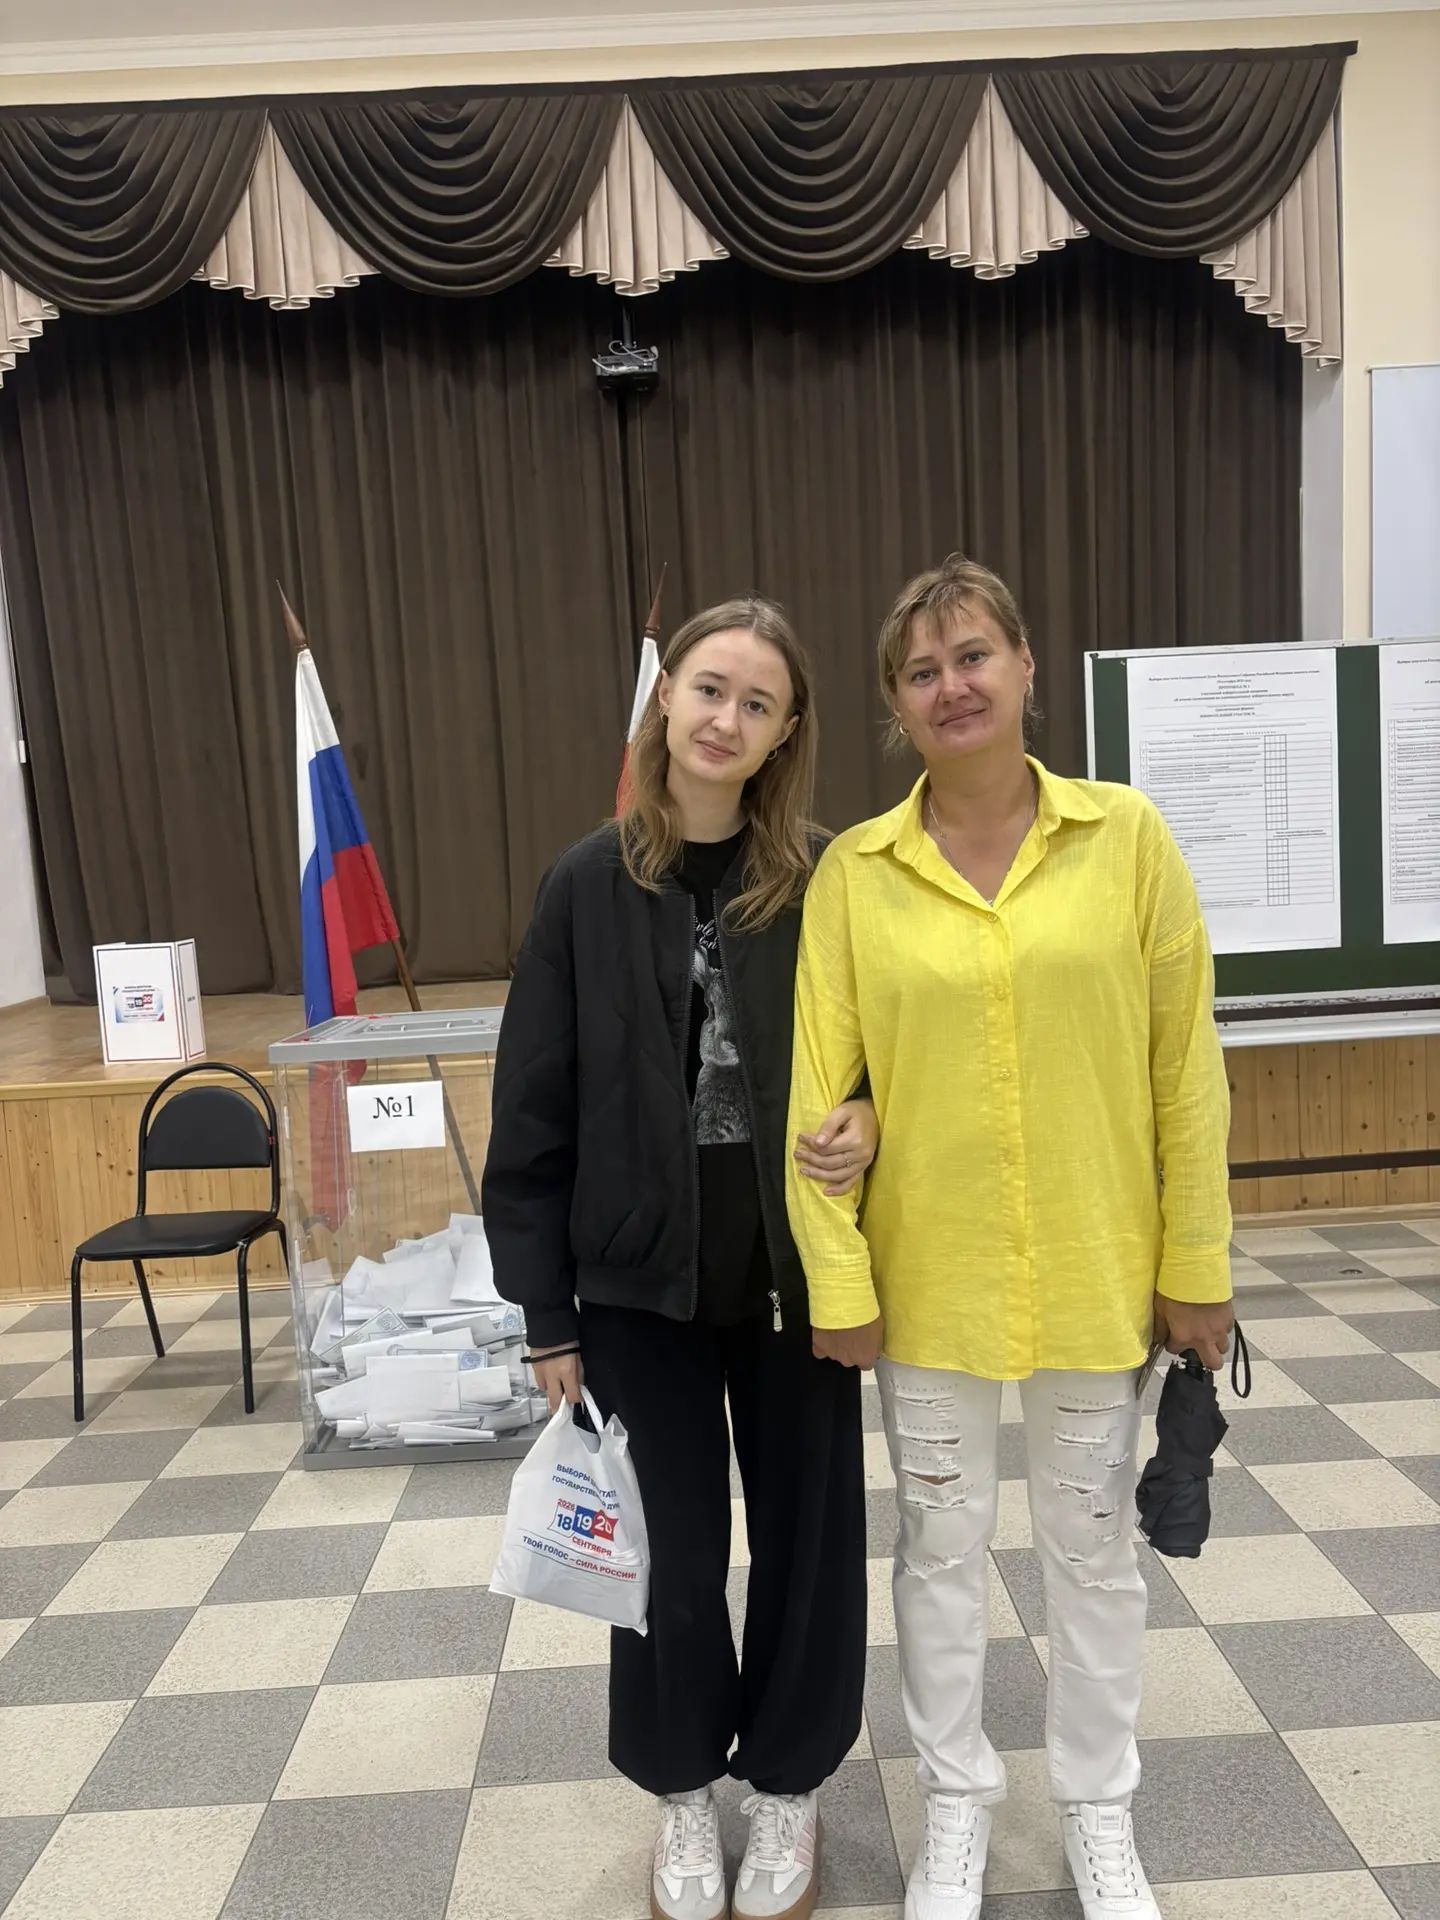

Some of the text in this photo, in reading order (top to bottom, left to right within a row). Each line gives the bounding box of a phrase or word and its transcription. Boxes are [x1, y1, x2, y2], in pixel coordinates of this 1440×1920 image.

[373, 1095, 414, 1119] №1
[556, 1464, 591, 1482] ВЫБОРЫ
[557, 1513, 613, 1535] 18 19 20
[572, 1536, 612, 1556] СЕНТЯБРЯ
[523, 1535, 543, 1550] ТВОЙ
[544, 1544, 569, 1561] ГОЛОС
[576, 1558, 598, 1571] СИЛА
[599, 1566, 637, 1580] РОССИИ!
